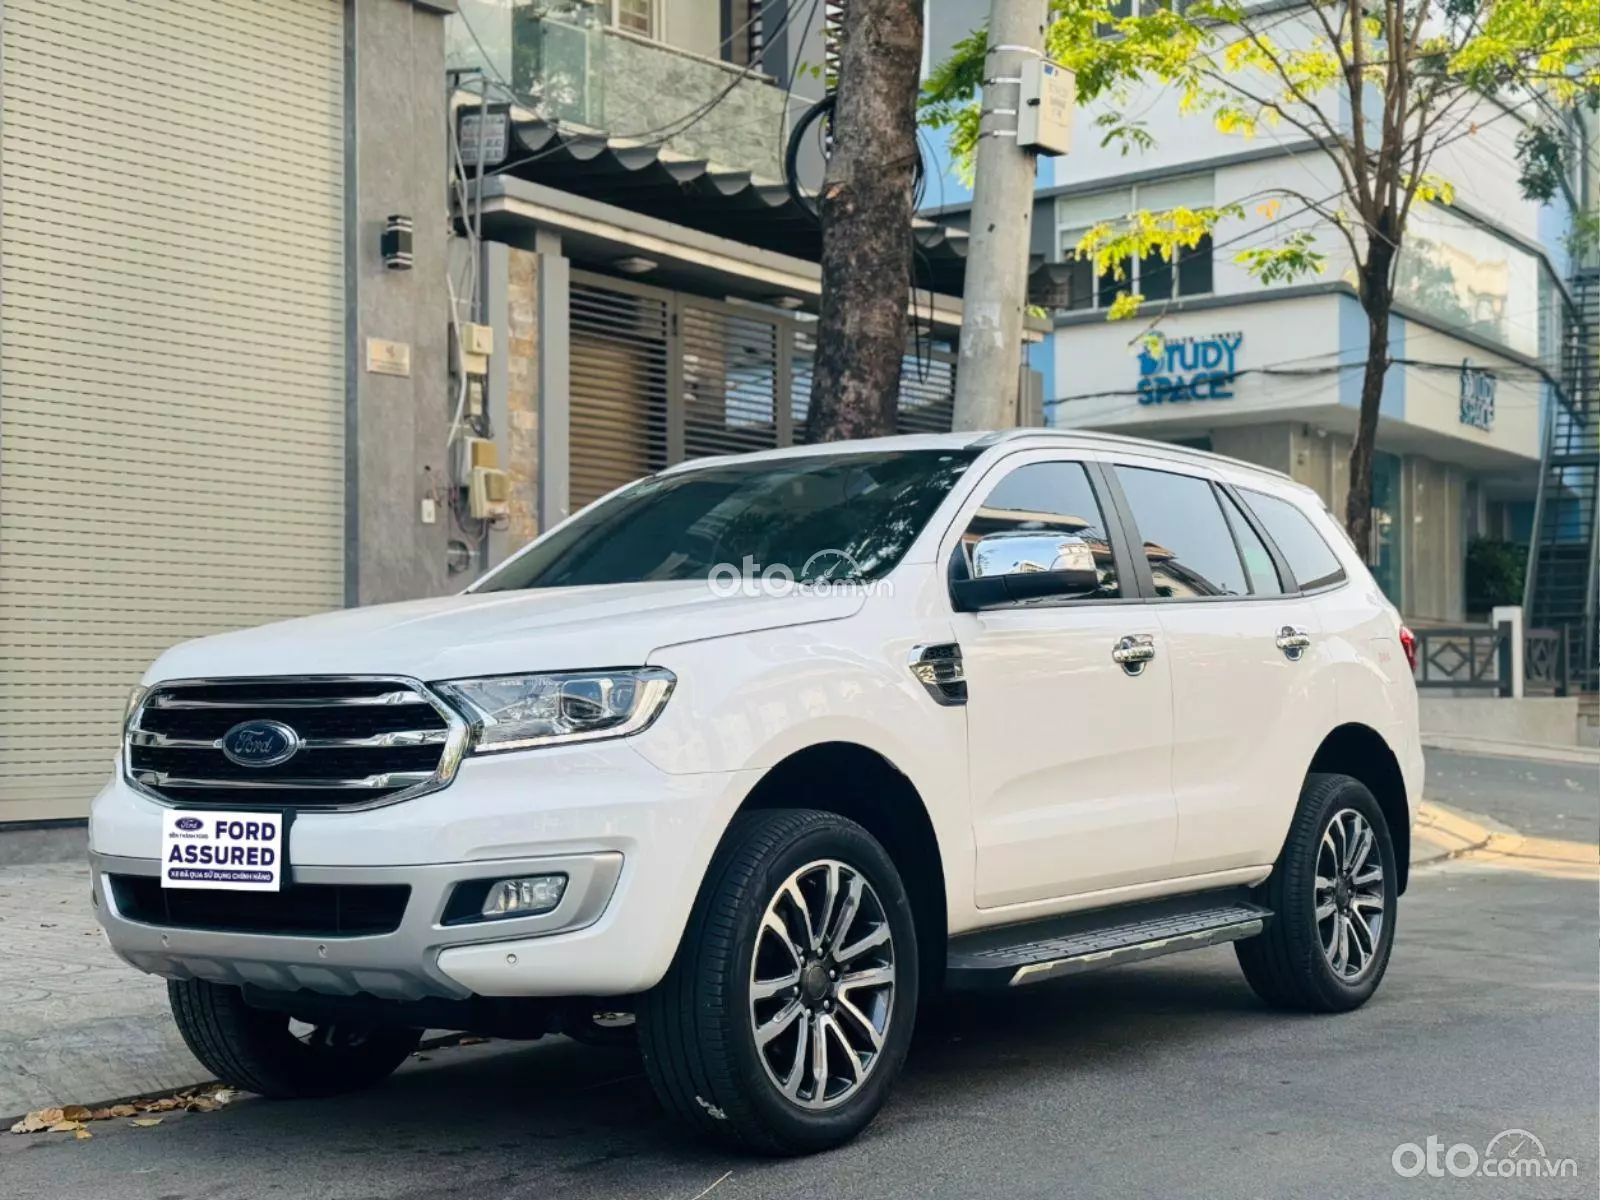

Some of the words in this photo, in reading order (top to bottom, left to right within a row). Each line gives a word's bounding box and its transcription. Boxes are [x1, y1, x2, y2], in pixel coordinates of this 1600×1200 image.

[1137, 371, 1234, 405] SPACE
[234, 729, 274, 753] Ford
[215, 820, 276, 841] FORD
[168, 844, 275, 866] ASSURED
[190, 871, 203, 880] QUA
